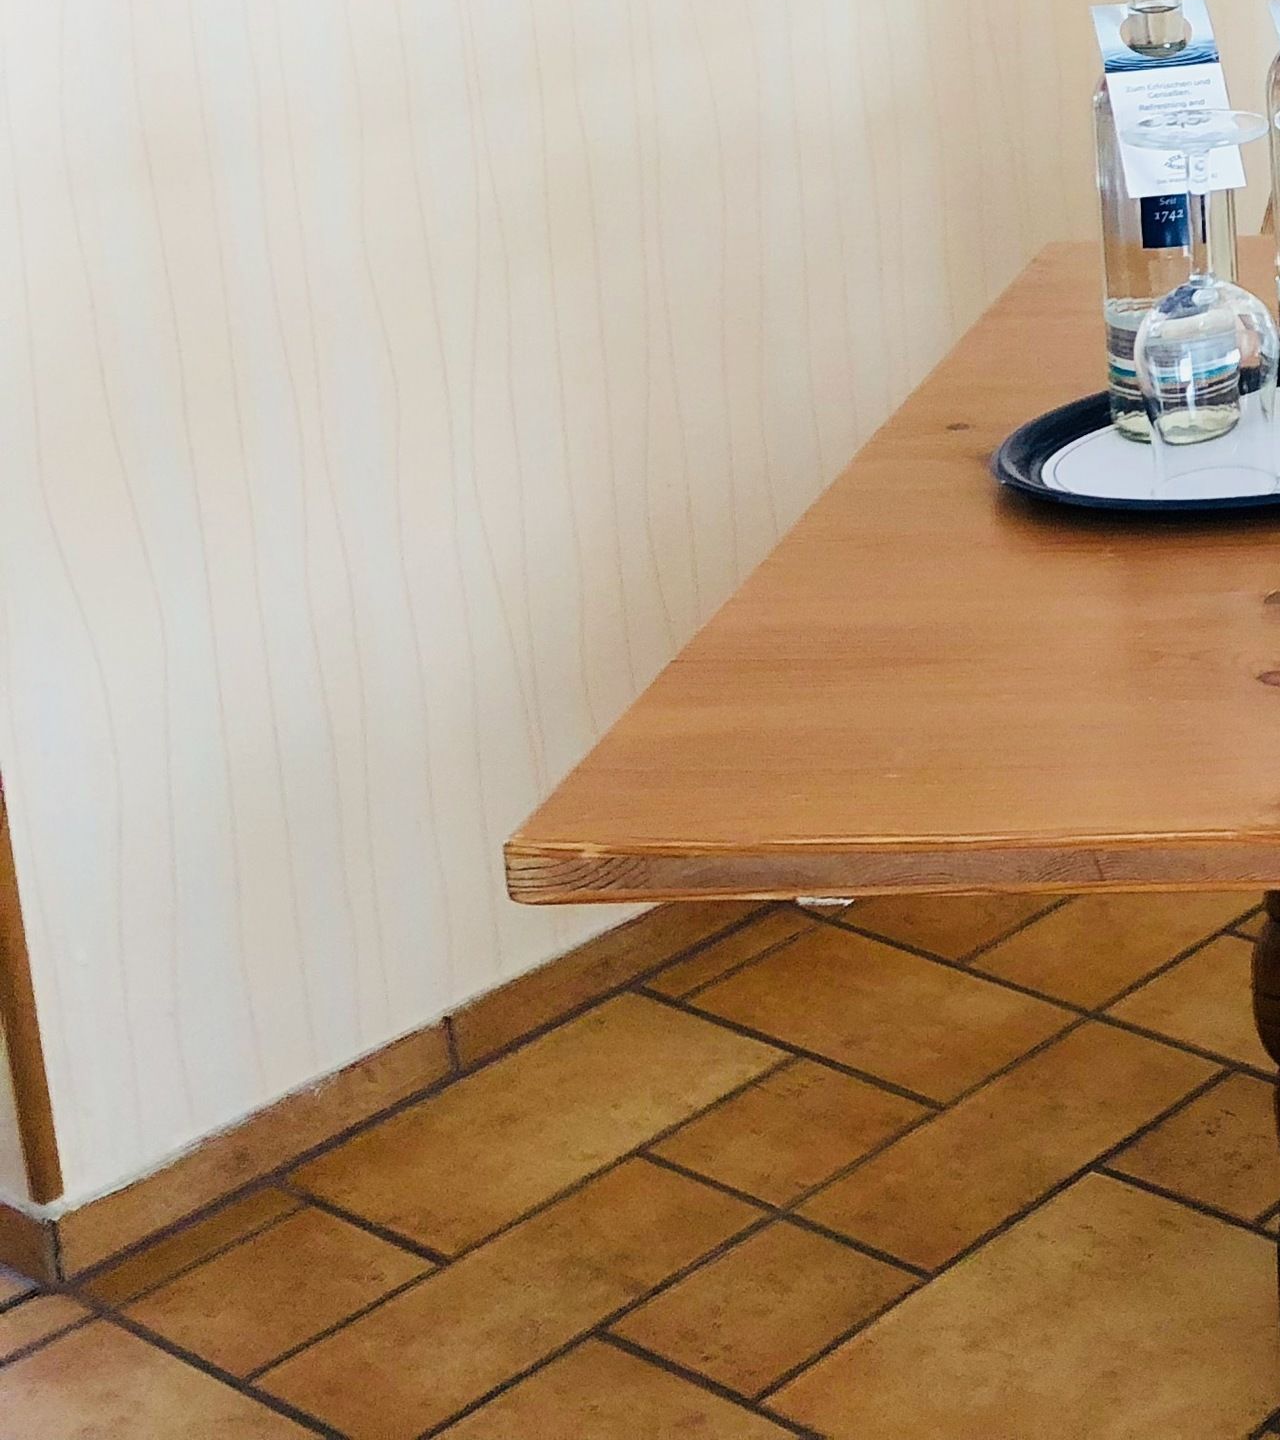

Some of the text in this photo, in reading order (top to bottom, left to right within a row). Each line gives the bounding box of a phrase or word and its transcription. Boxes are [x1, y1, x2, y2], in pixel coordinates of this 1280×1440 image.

[1126, 85, 1146, 93] Zum
[1193, 78, 1212, 86] und
[1139, 99, 1206, 111] Refreshing and
[1160, 197, 1177, 206] Seit
[1154, 209, 1184, 223] 1742
